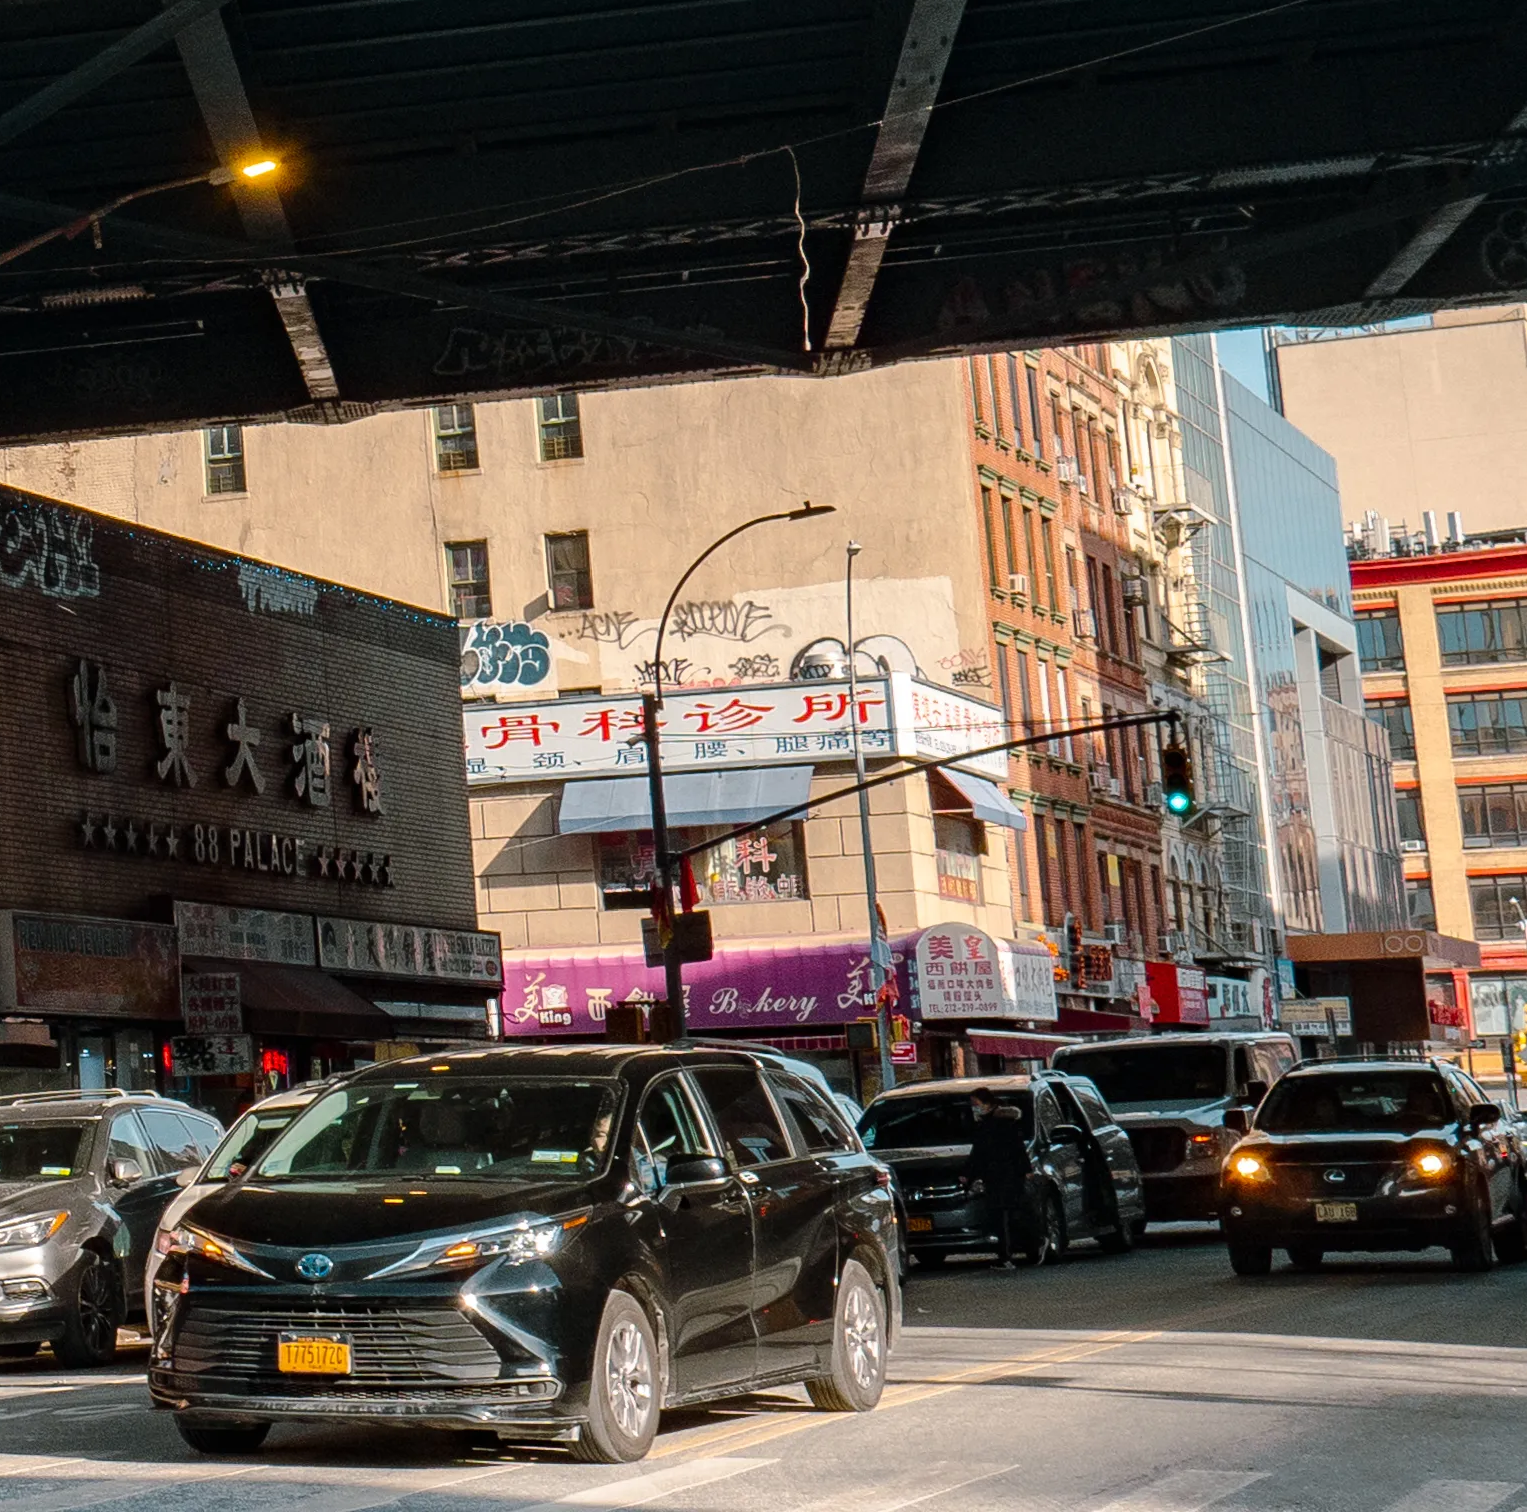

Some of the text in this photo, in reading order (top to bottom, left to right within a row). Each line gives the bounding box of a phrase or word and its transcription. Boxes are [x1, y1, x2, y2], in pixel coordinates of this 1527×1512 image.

[194, 823, 308, 878] 88 PALACE
[1378, 934, 1424, 954] 100
[538, 1008, 573, 1026] King
[285, 1344, 344, 1366] T775172C
